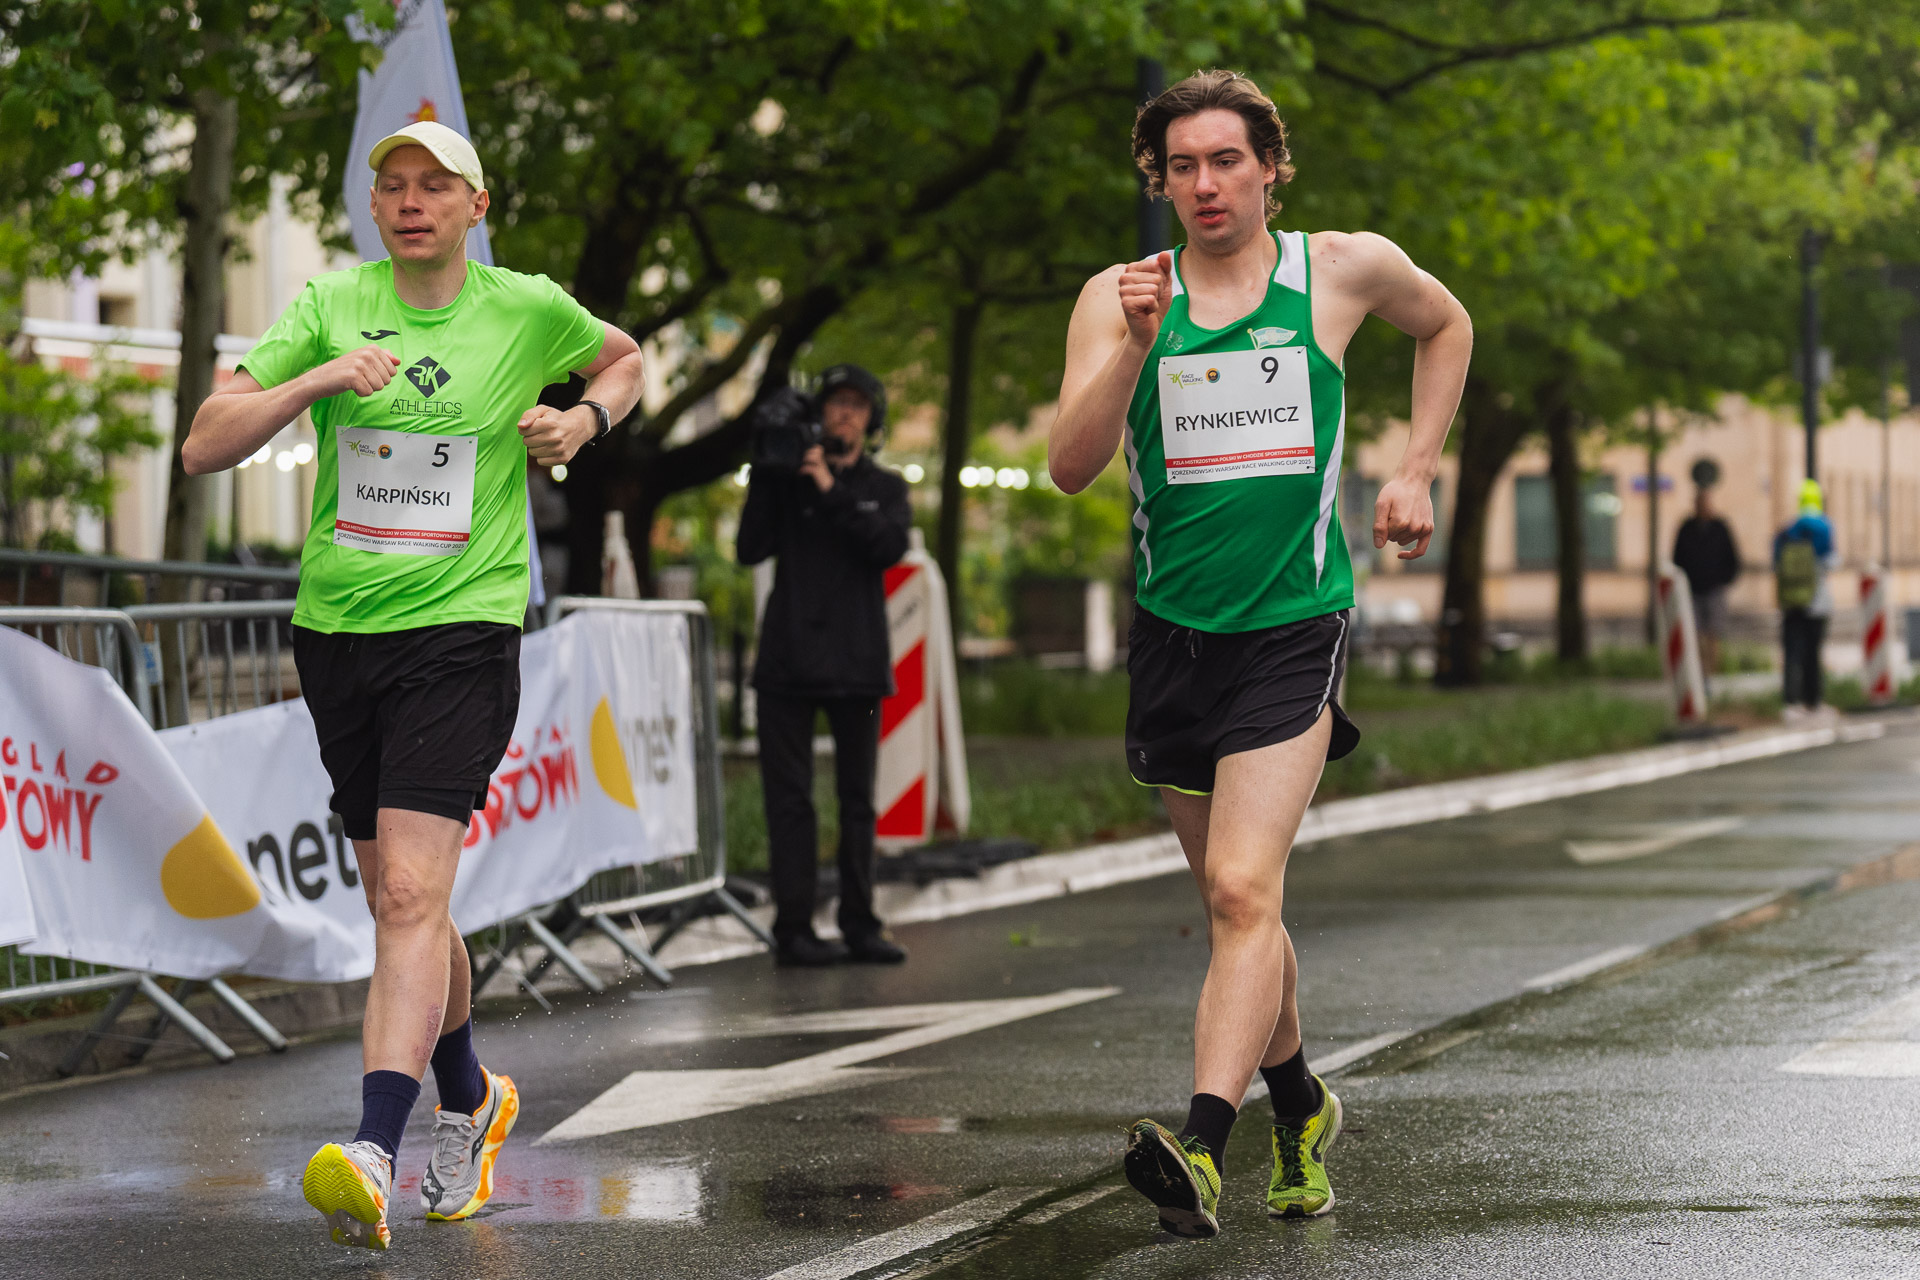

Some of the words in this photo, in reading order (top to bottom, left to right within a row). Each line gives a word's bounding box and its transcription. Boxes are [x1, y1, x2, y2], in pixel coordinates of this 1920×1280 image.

[1261, 356, 1279, 384] 9
[390, 398, 462, 415] ATHLETICS
[1175, 406, 1300, 432] RYNKIEWICZ
[360, 448, 377, 456] WALKING
[431, 443, 450, 468] 5
[1184, 457, 1220, 465] MISTRZOSTWA
[1264, 449, 1296, 457] SPORTOWYM
[1172, 468, 1214, 476] KORZENIOWSKI
[1215, 465, 1241, 473] WARSAW
[1258, 460, 1286, 468] WALKING
[356, 483, 450, 507] KARPIŃSKI
[338, 532, 371, 544] KORZENIOWSKI
[350, 525, 377, 535] MISTRZOSTWA
